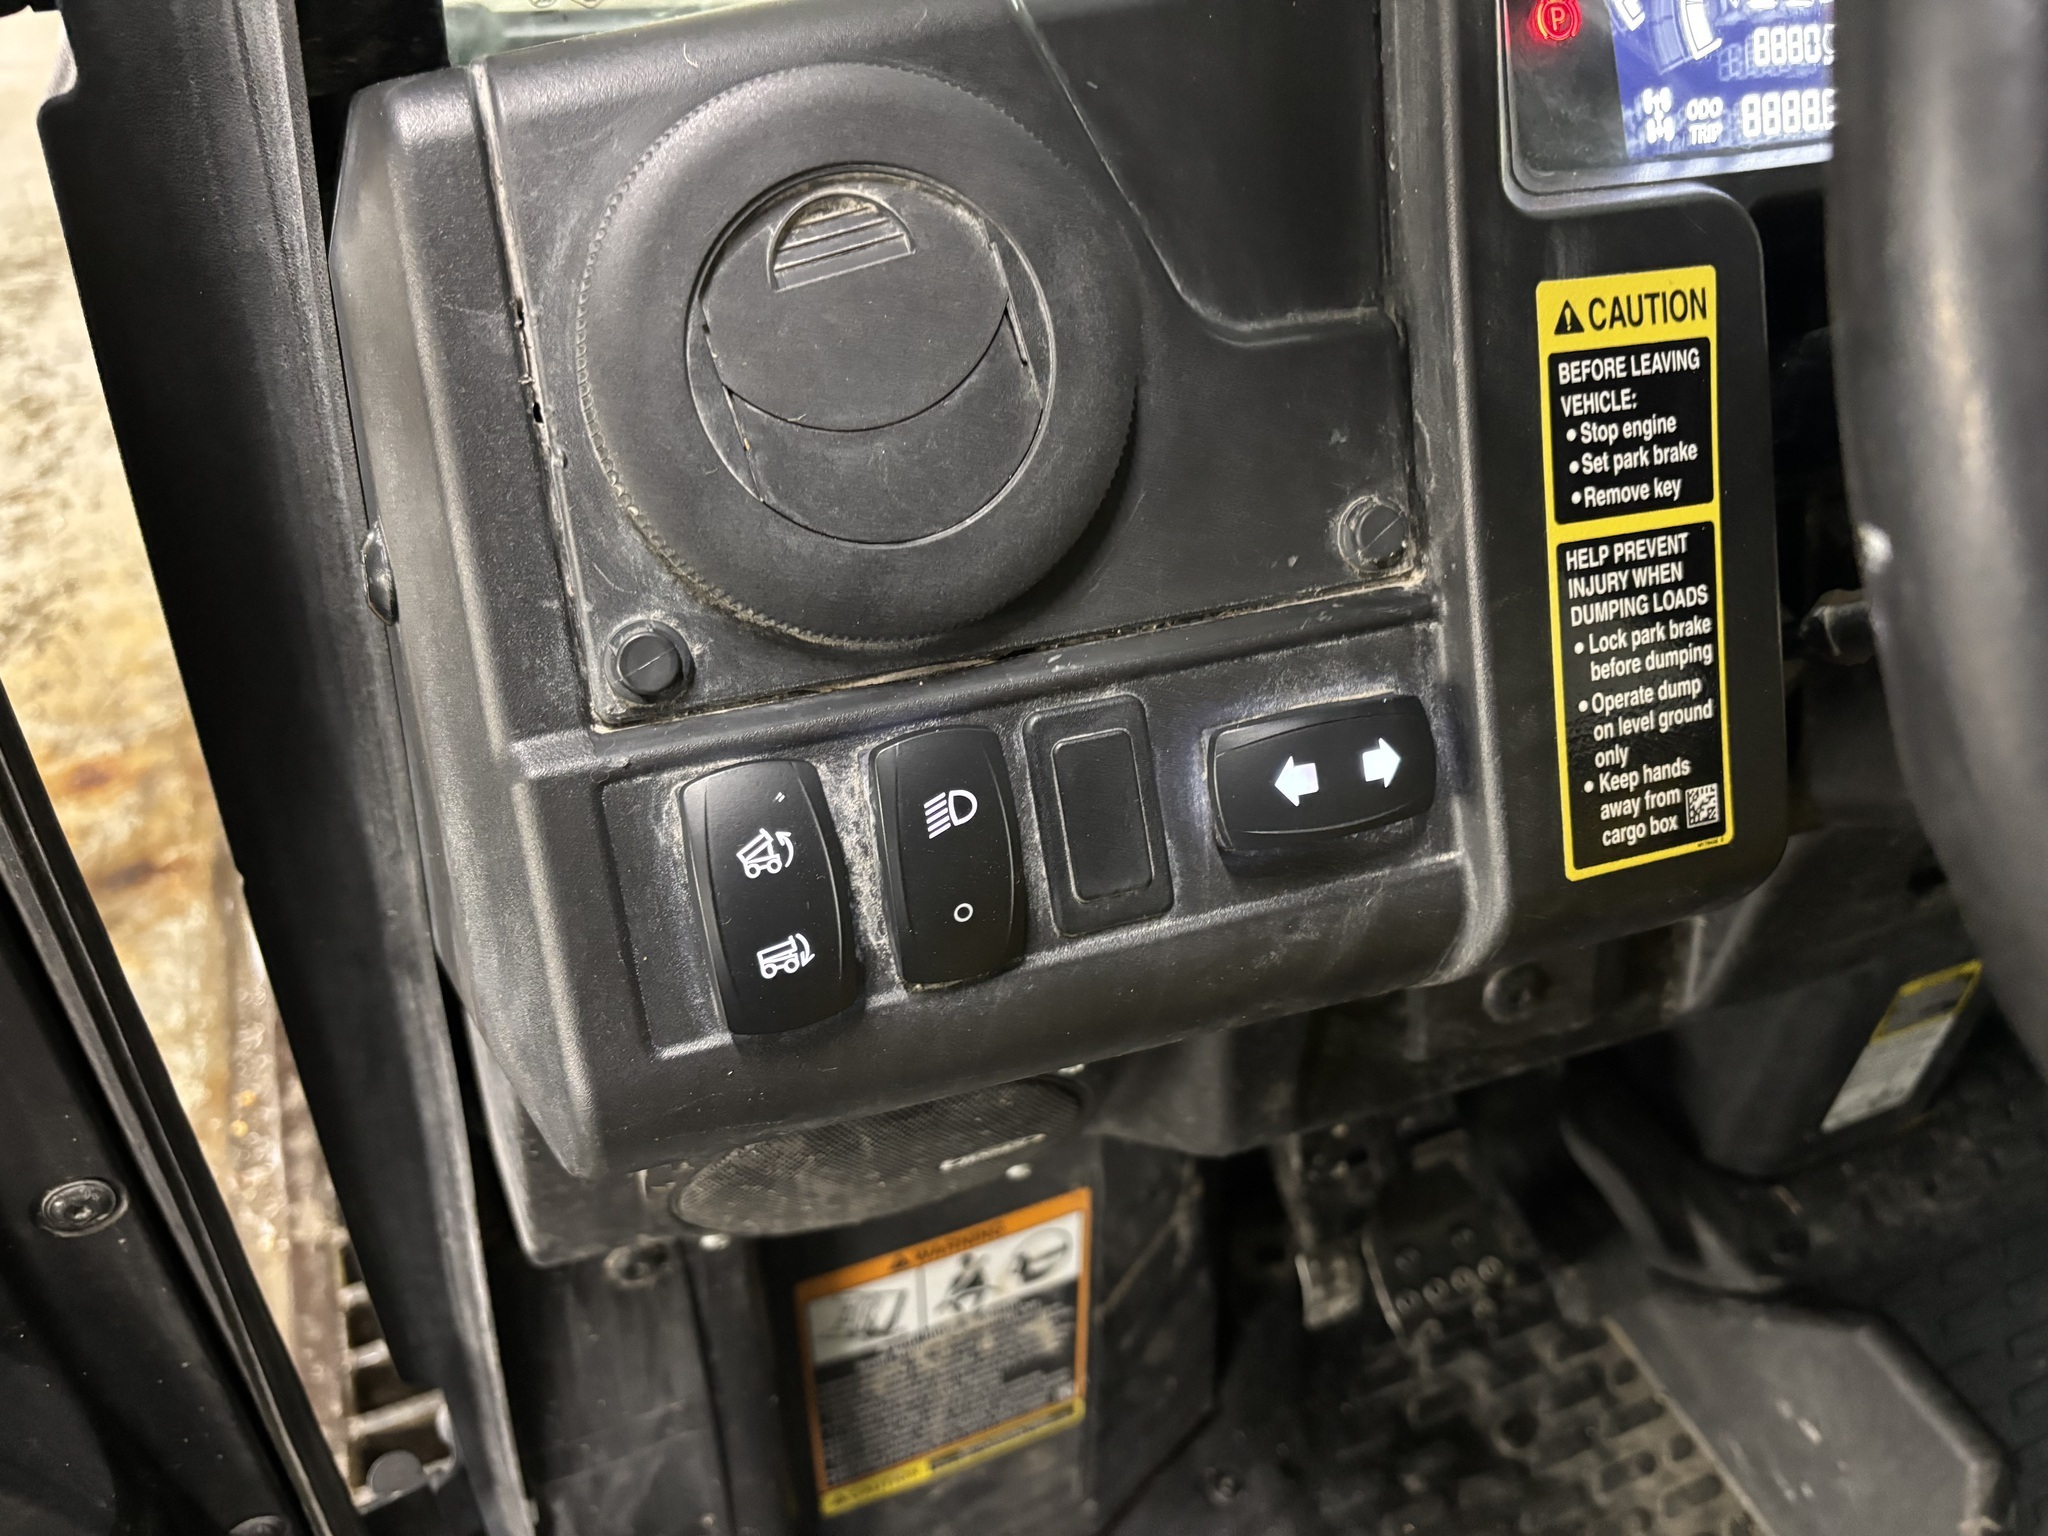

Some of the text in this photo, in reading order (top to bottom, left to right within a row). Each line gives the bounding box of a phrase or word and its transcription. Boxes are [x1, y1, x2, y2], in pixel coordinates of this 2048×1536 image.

[1687, 96, 1723, 121] ODO
[1689, 122, 1724, 145] TRIP
[1589, 288, 1707, 331] CAUTION
[1558, 348, 1700, 384] BEFORE LEAVING
[1561, 388, 1637, 417] VEHICLE:
[1581, 413, 1677, 446] Stop engine
[1582, 441, 1698, 476] Set park brake
[1584, 477, 1682, 508] Remove key
[1566, 532, 1690, 571] HELP PREVENT
[1568, 561, 1684, 599] INJURY WHEN
[1571, 584, 1709, 627] DUMPING LOADS
[1589, 615, 1712, 654] Lock park brake
[1591, 643, 1713, 681] before dumping
[1592, 678, 1702, 716] Operate dump
[1594, 698, 1714, 741] on level ground
[1595, 744, 1629, 769] only
[1599, 757, 1691, 793] Keep hands
[1601, 787, 1681, 820] away from
[1602, 815, 1679, 846] cargo box
